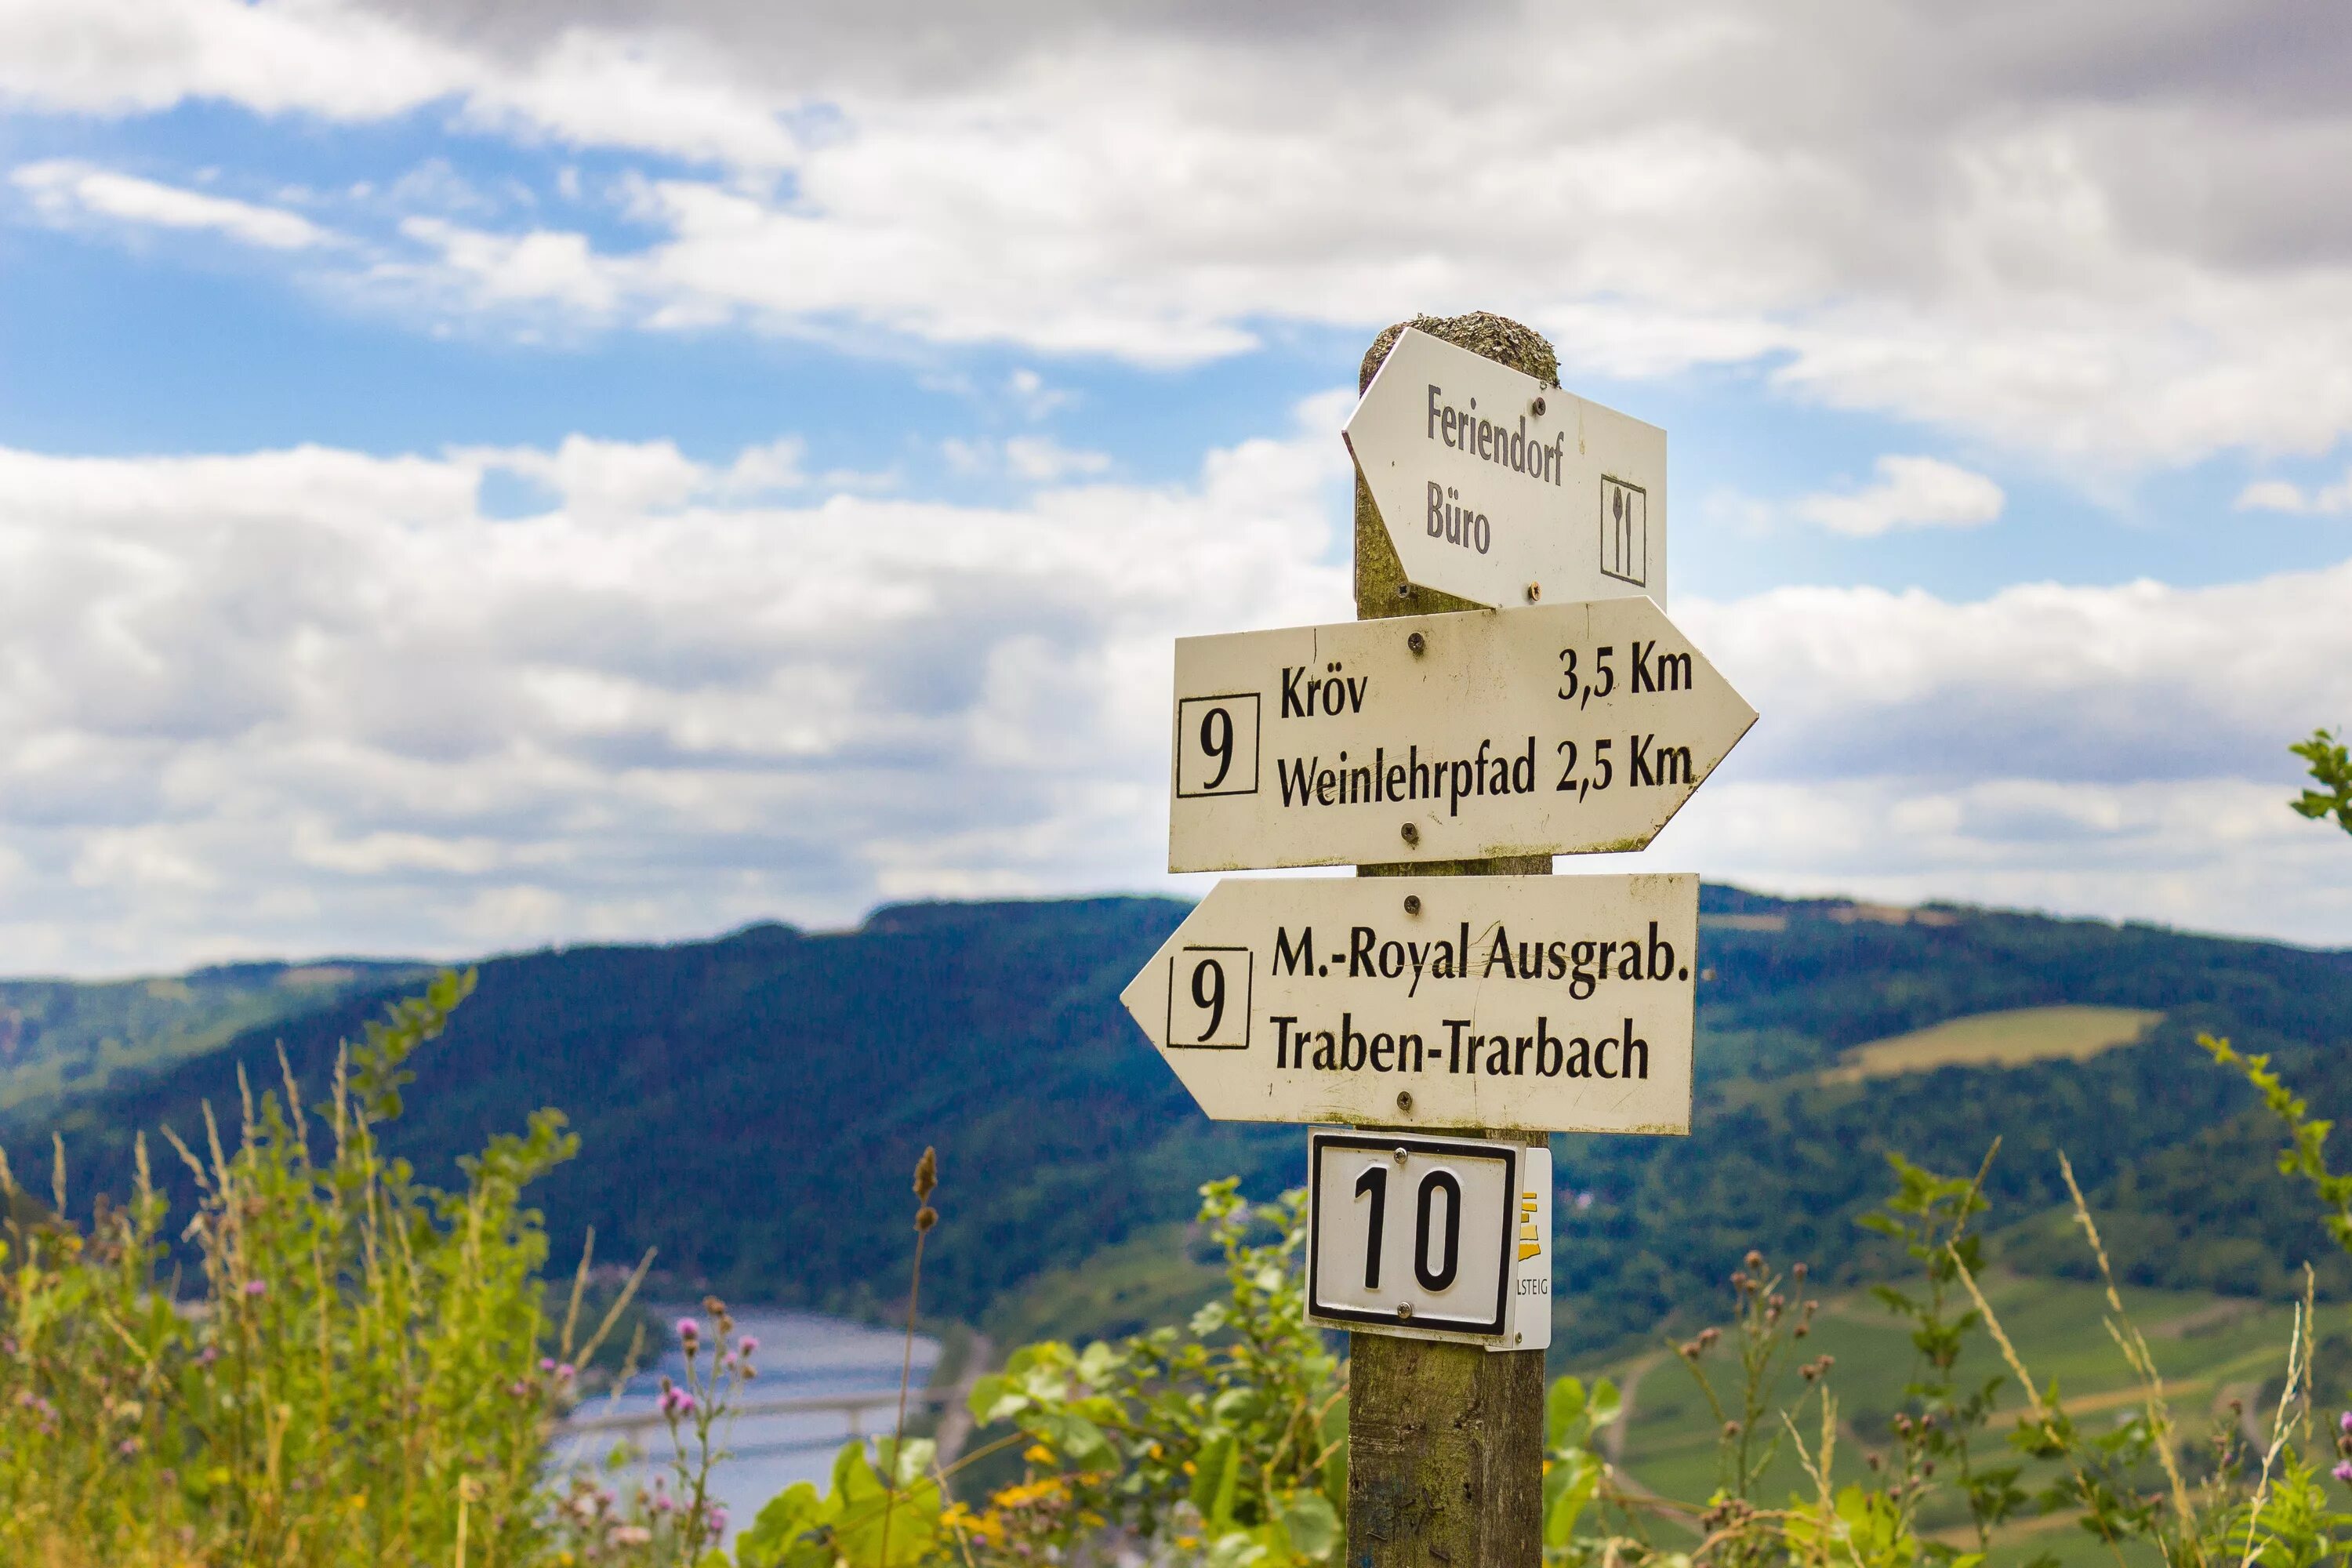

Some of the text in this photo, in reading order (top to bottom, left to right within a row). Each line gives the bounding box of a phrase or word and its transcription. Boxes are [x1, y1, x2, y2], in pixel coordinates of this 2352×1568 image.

[1428, 383, 1564, 486] Feriendorf
[1427, 481, 1490, 555] Büro
[1281, 640, 1693, 719] Kröv 3,5 Km
[1200, 707, 1235, 790] 9
[1277, 733, 1692, 817] Weinlehrpfad 2,5 Km
[1191, 958, 1225, 1042] 9
[1272, 921, 1689, 1000] M.-Royal Ausgrab.
[1270, 1012, 1649, 1080] Traben-Trarbach
[1355, 1166, 1461, 1292] 10
